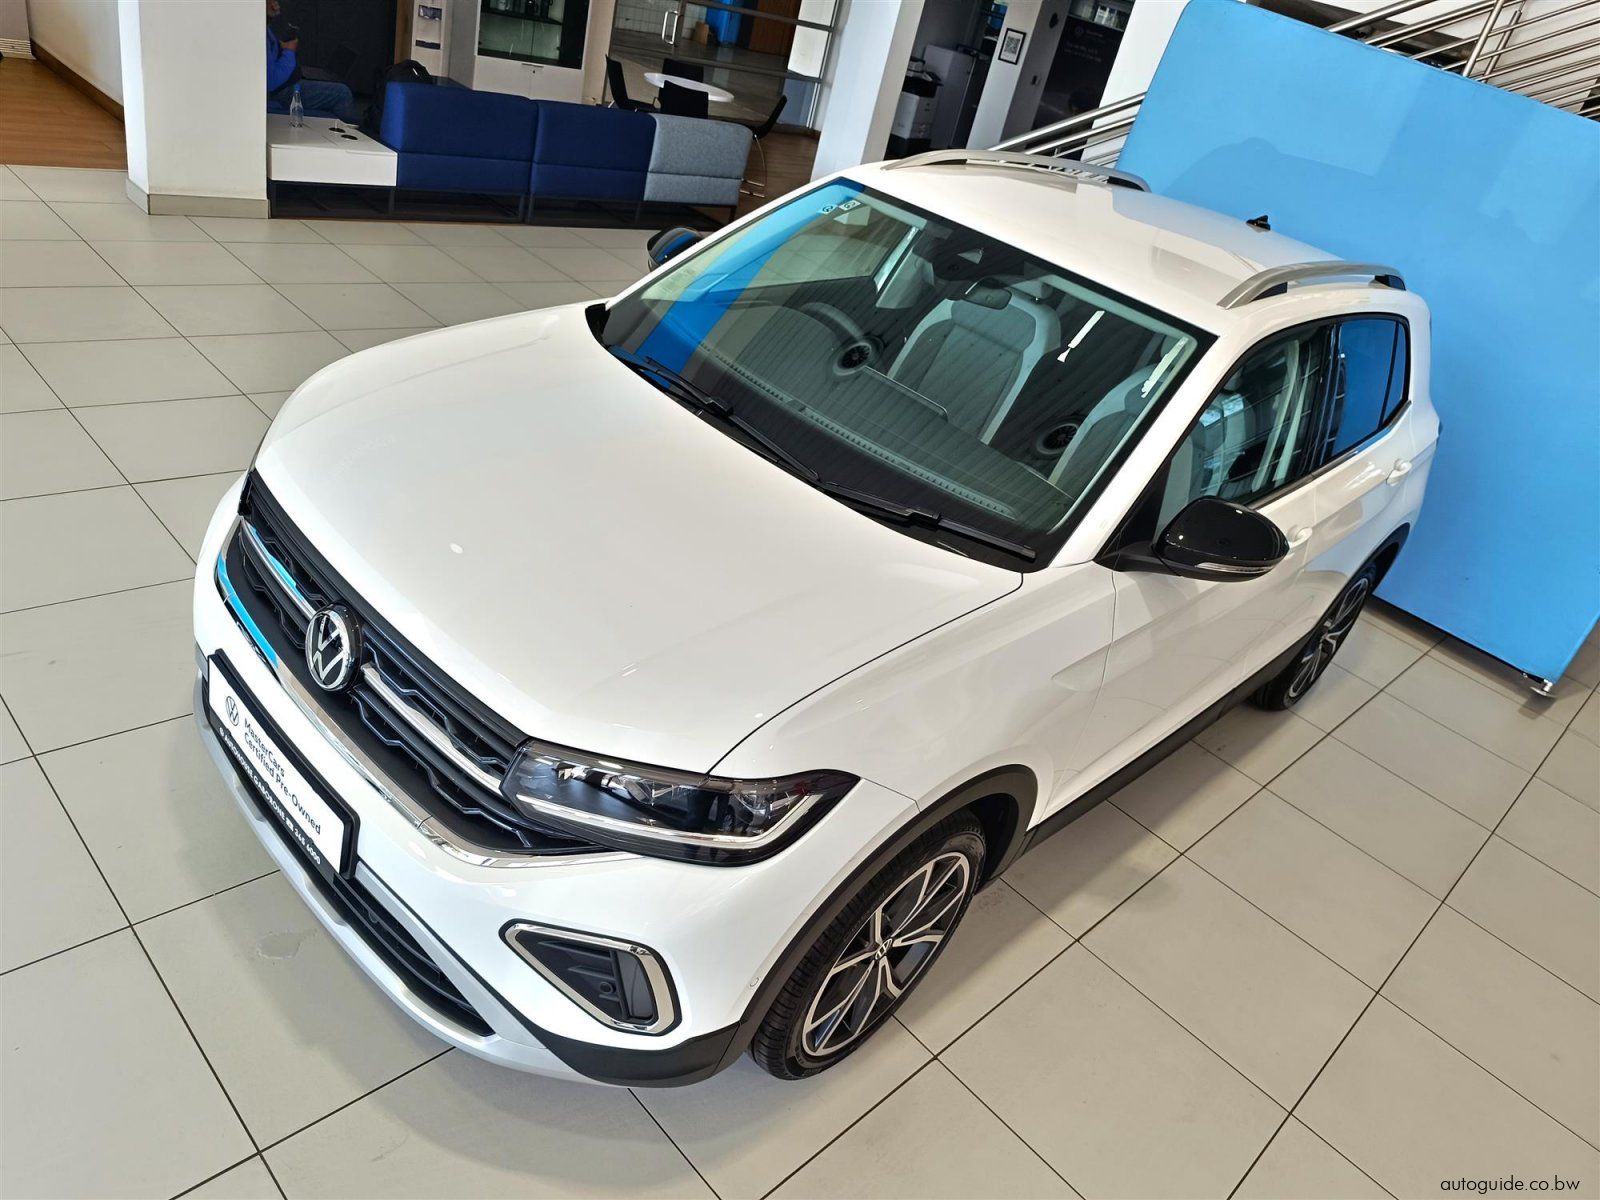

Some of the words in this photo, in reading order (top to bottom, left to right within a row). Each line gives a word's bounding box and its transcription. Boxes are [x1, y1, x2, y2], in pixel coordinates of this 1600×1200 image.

[244, 717, 285, 778] MasterCars
[244, 732, 275, 778] Certified
[275, 771, 321, 835] Pre-Owned
